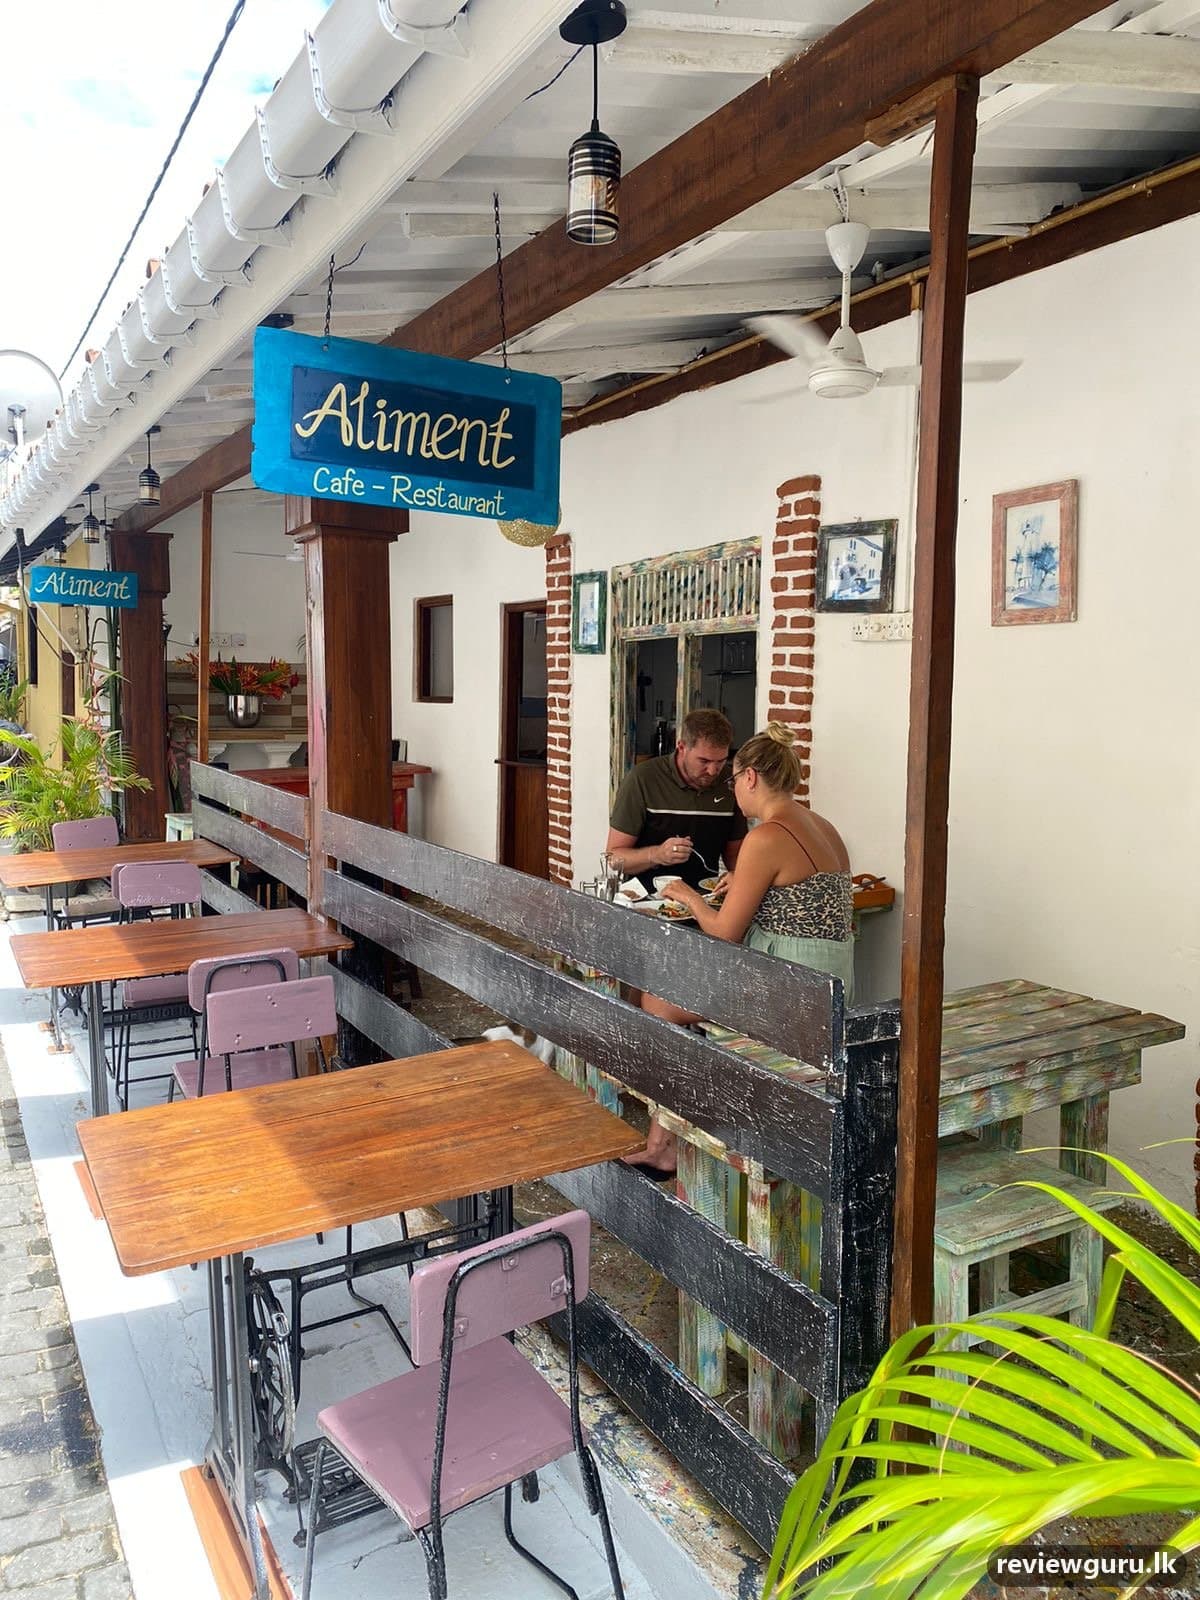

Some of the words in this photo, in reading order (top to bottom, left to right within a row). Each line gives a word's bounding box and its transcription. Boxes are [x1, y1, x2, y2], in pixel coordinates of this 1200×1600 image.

[295, 381, 515, 469] Aliment
[312, 466, 365, 496] Cafe
[390, 475, 506, 517] Restaurant
[35, 571, 131, 600] Aliment
